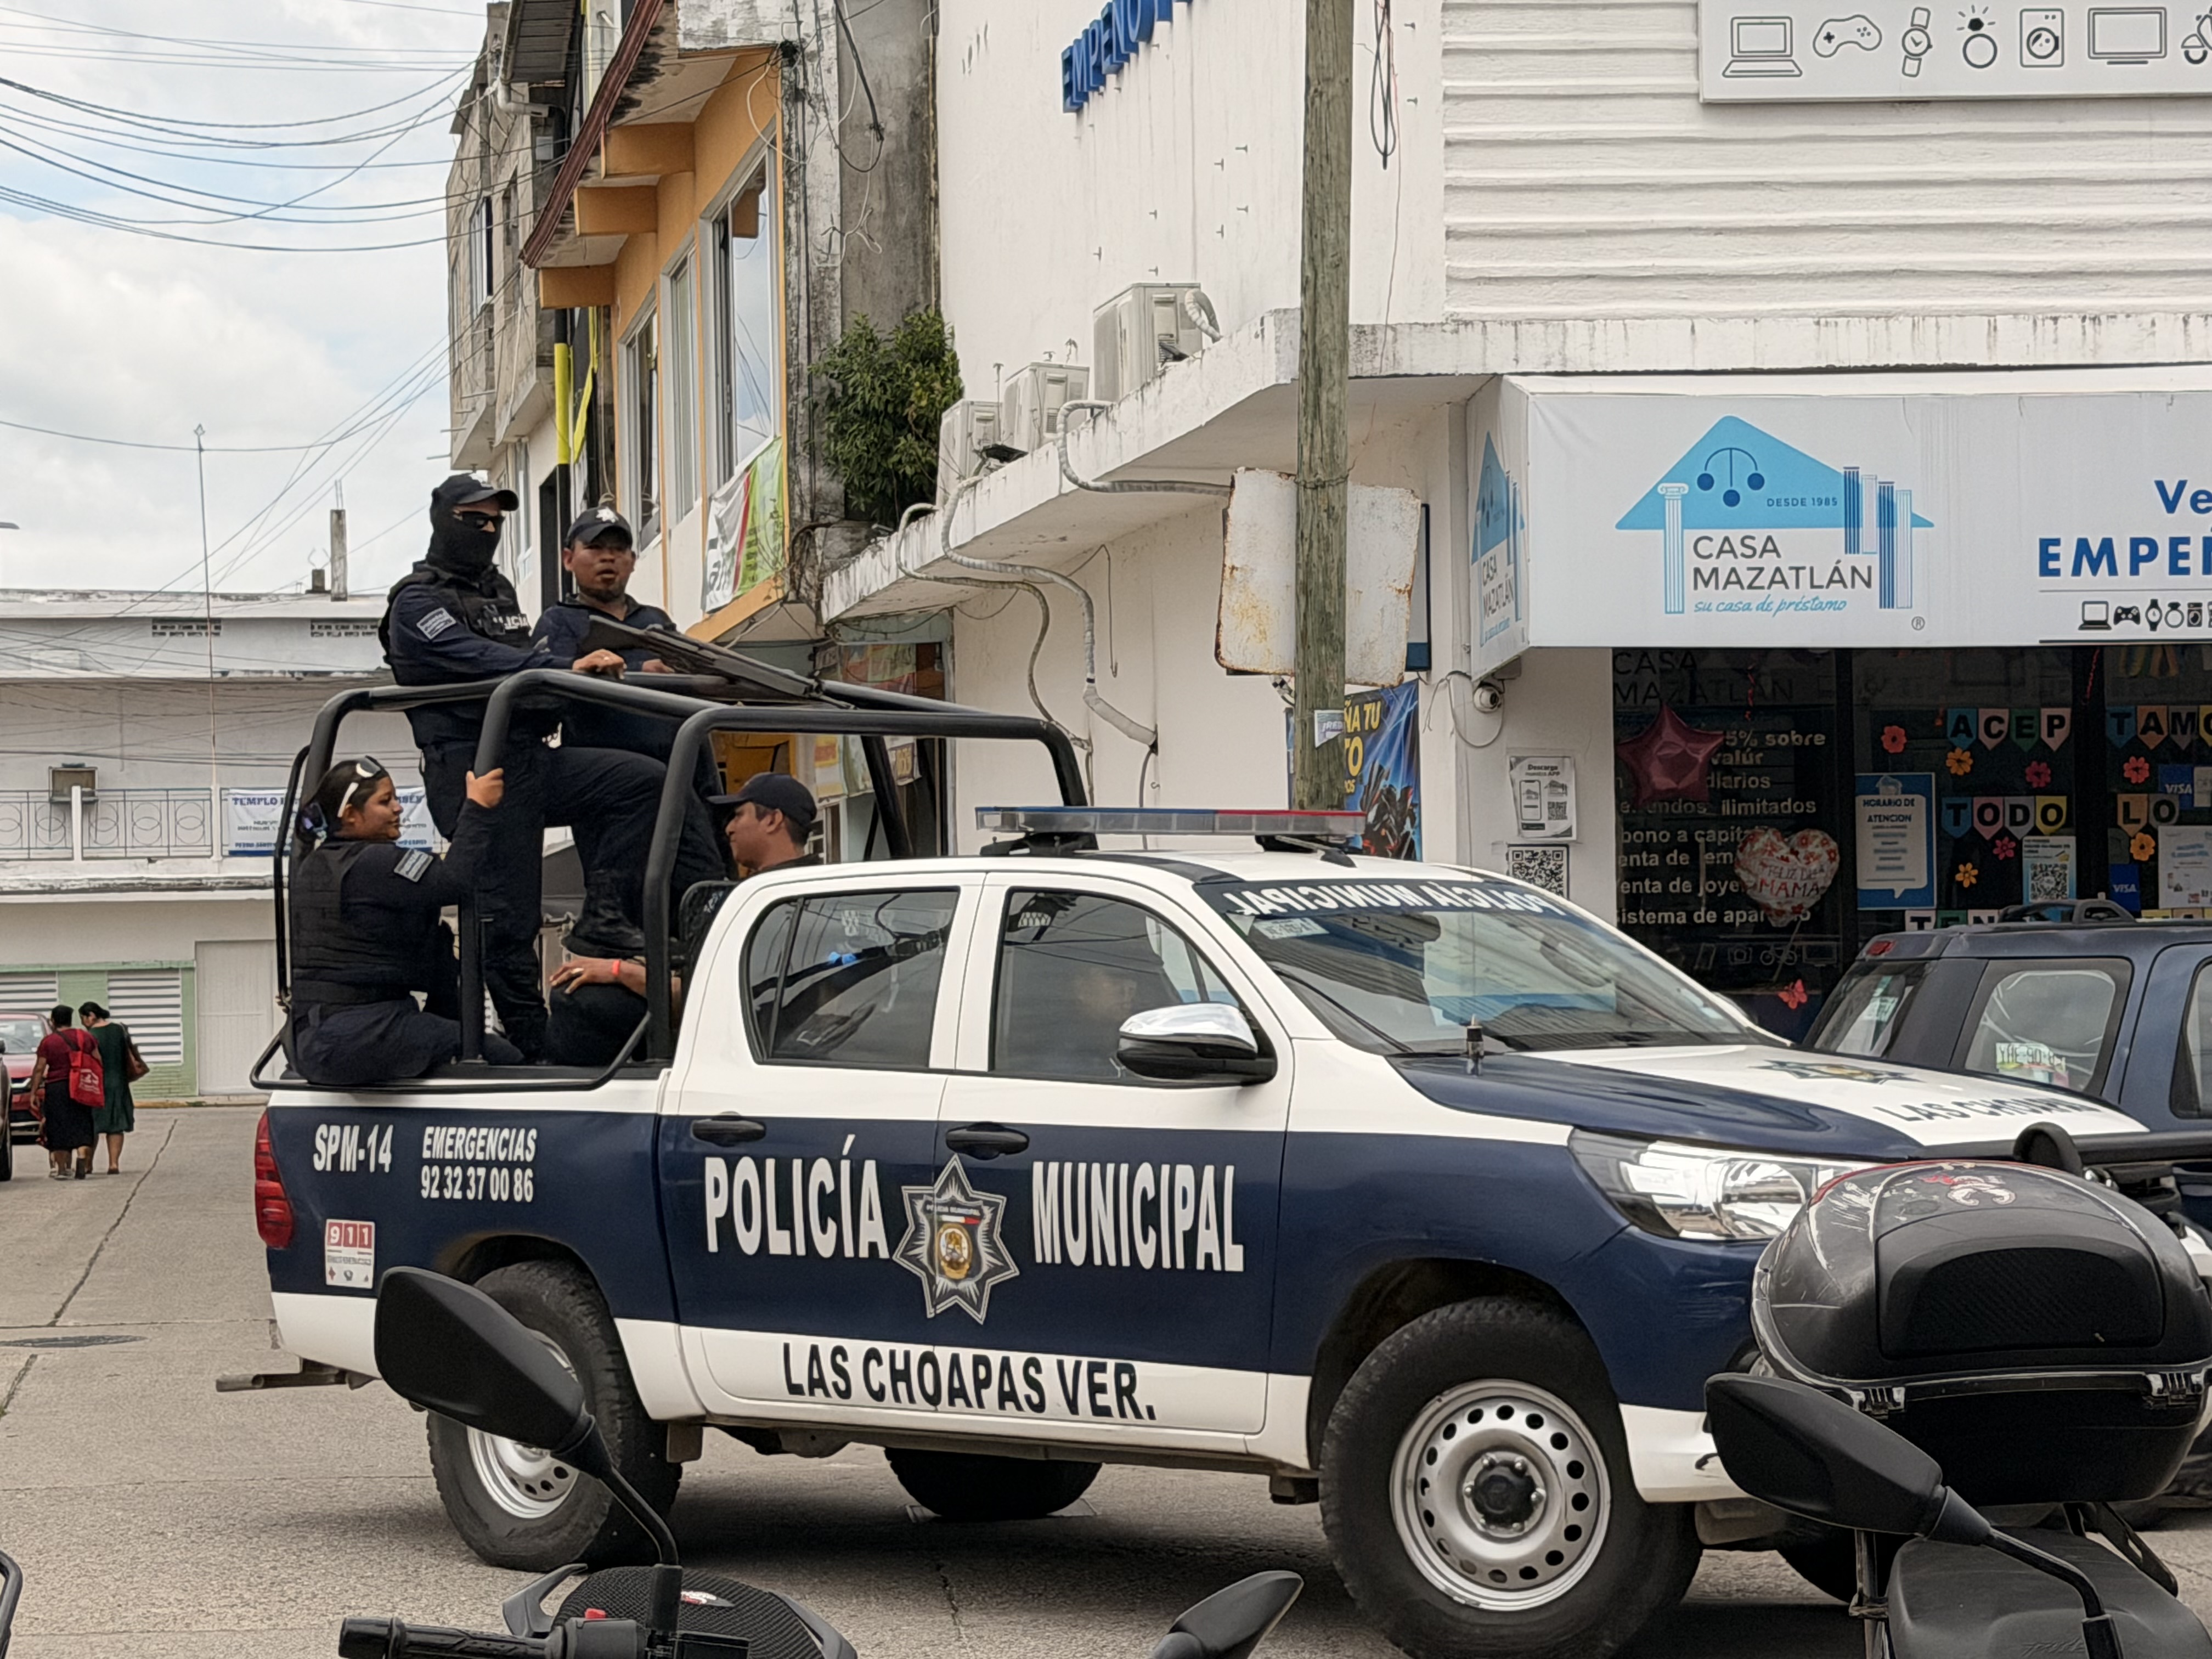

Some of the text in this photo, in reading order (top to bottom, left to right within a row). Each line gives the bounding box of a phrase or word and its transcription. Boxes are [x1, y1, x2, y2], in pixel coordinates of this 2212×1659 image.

[1767, 497, 1838, 507] DESDE 1985
[1693, 535, 1781, 560] CASA
[1693, 561, 1872, 591] MAZATLÁN
[1694, 594, 1847, 617] su casa de préstamo
[1364, 701, 1381, 730] TU
[1950, 713, 2066, 740] ACEP
[1765, 730, 1826, 747] sobre
[2165, 783, 2192, 794] VISA
[1721, 797, 1817, 815] ilimitados
[1950, 799, 2176, 824] TODO LO
[1677, 831, 1688, 843] a
[1618, 851, 1660, 867] enta
[1666, 849, 1690, 866] de
[1620, 879, 1663, 894] enta
[1669, 876, 1692, 894] de
[2113, 883, 2138, 893] VISA
[1693, 907, 1717, 924] de
[313, 1124, 394, 1173] SPM-14
[422, 1126, 538, 1162] EMERGENCIAS
[421, 1165, 533, 1202] 92 32 37 00 86
[705, 1134, 1244, 1272] POLICÍA MUNICIPAL
[330, 1225, 369, 1246] 911
[783, 1341, 1156, 1421] LAS CHOAPAS VER.
